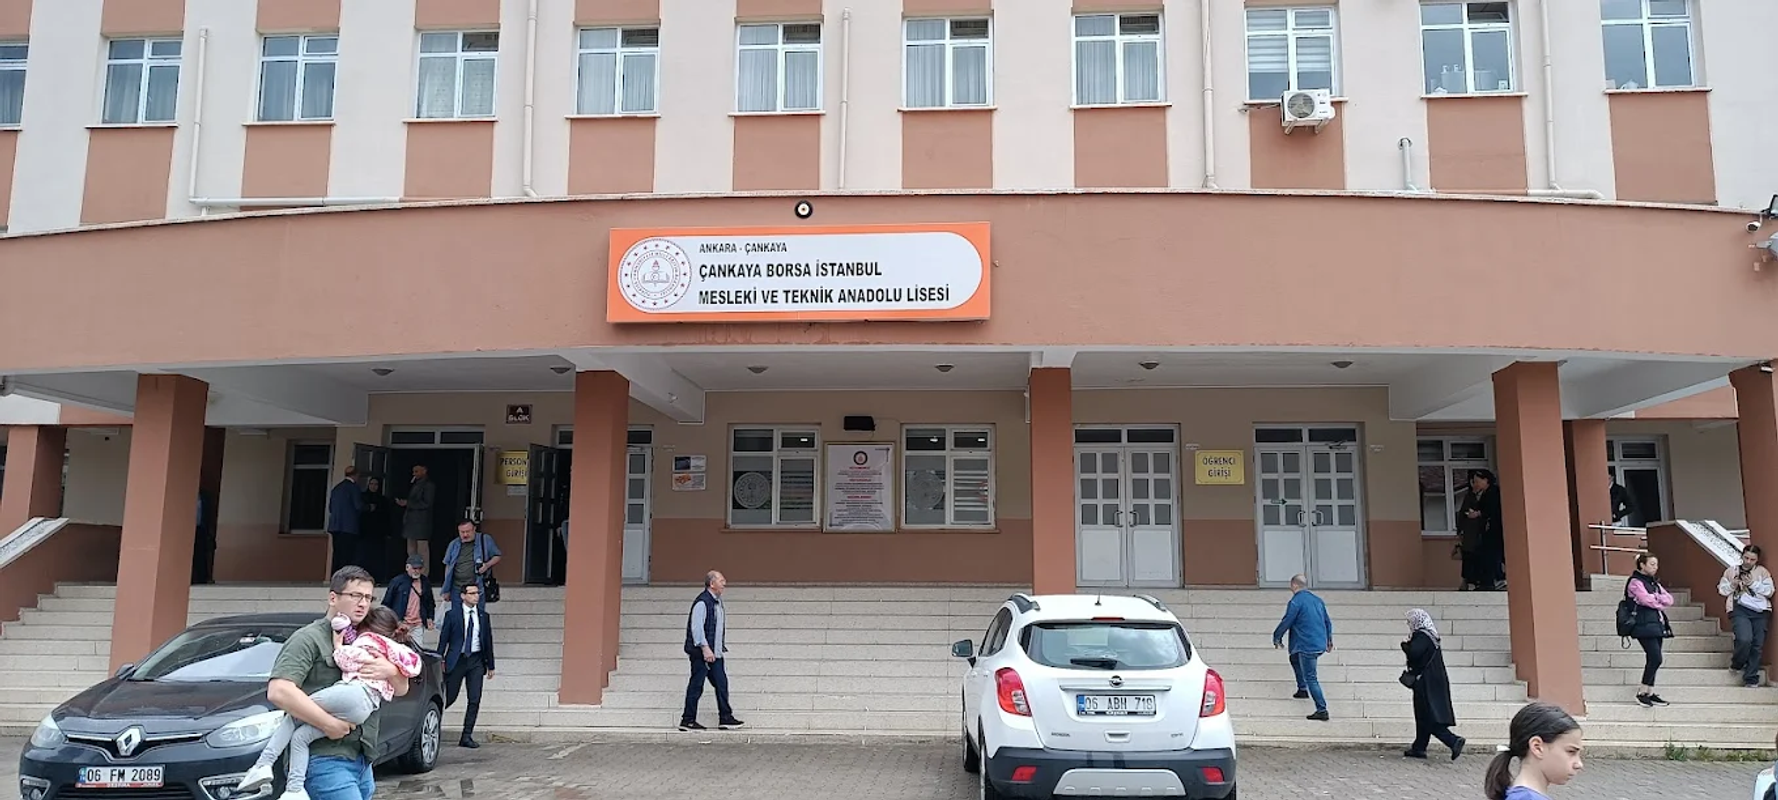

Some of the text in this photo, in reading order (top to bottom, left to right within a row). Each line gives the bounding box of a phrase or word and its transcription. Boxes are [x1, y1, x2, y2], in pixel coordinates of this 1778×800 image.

[699, 243, 738, 254] ANKARA
[744, 242, 788, 255] ÇANKAYA
[699, 259, 883, 282] ÇANKAYA BORSA İSTANBUL
[698, 283, 950, 305] MESLEKİ VE TEKNİK ANADOLU LİSESİ
[516, 406, 524, 414] A
[499, 457, 527, 467] PERSON
[1085, 697, 1098, 710] 06
[1107, 697, 1128, 710] ABH
[87, 769, 101, 782] 06
[131, 768, 161, 782] 2089
